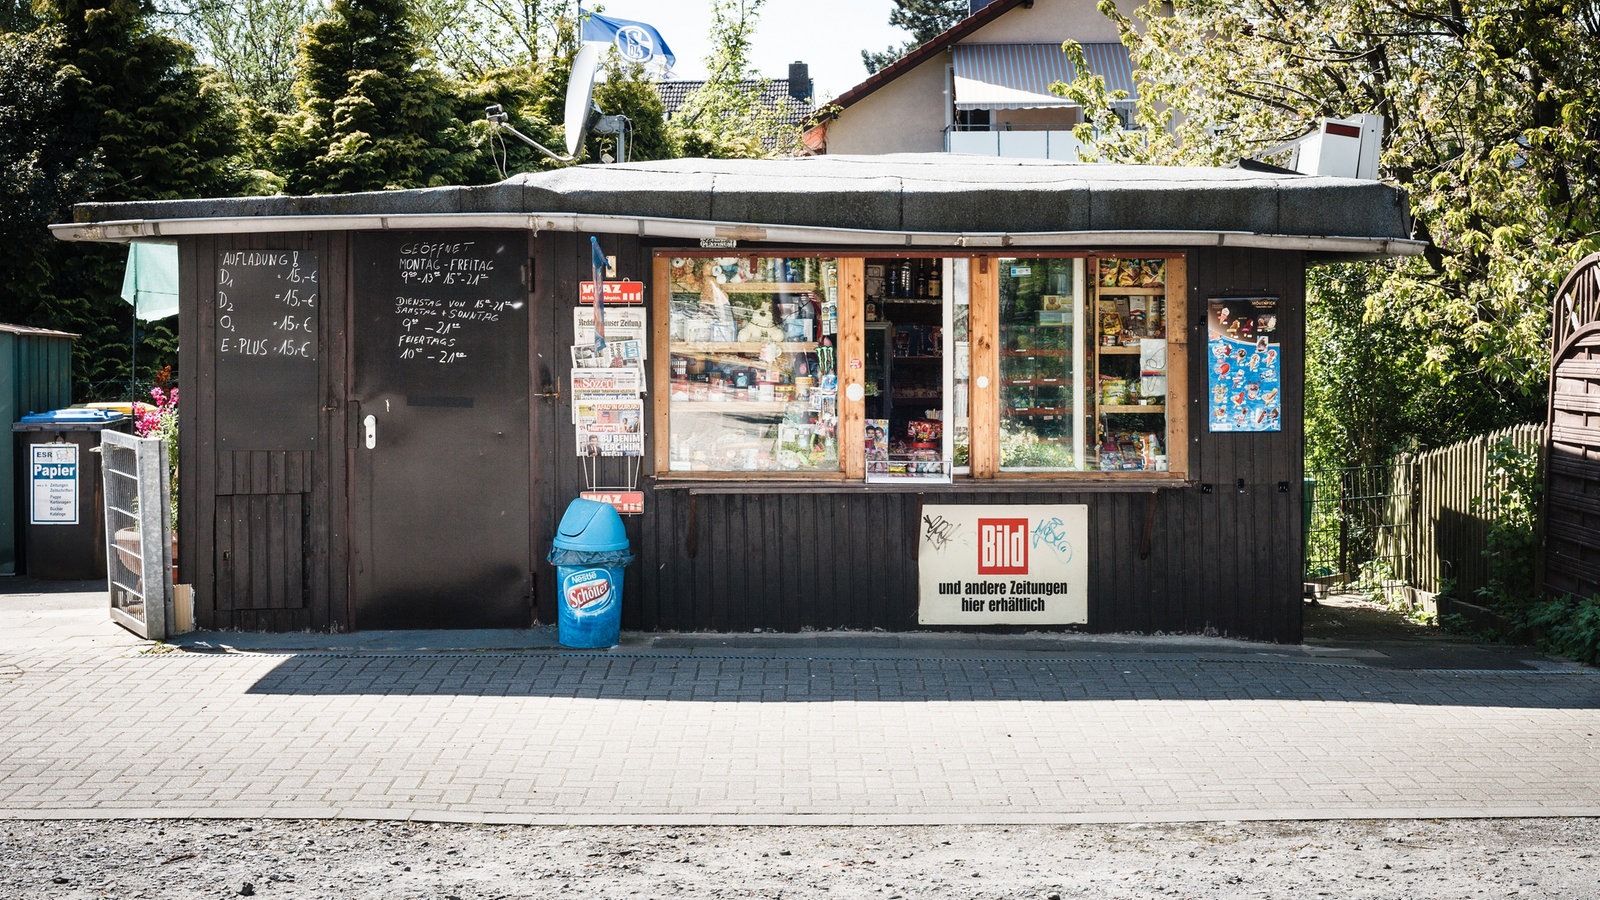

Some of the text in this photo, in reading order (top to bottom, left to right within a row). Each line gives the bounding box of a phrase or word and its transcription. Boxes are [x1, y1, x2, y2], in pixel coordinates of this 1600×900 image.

[400, 242, 475, 258] GEÖFFNET
[222, 252, 288, 266] AUFLADUNG
[582, 284, 621, 293] WAZ
[395, 297, 442, 307] DIENSTAG
[395, 307, 436, 315] SAMSTAG
[448, 309, 499, 321] SONNTAG
[398, 335, 456, 347] FEIERTAGS
[34, 464, 75, 478] Papier
[982, 525, 1025, 568] Bild
[571, 571, 597, 584] Nestlé
[570, 582, 608, 607] Schöller
[939, 581, 1067, 596] und andere Zeitungen
[961, 598, 1045, 612] hier erhältlich
